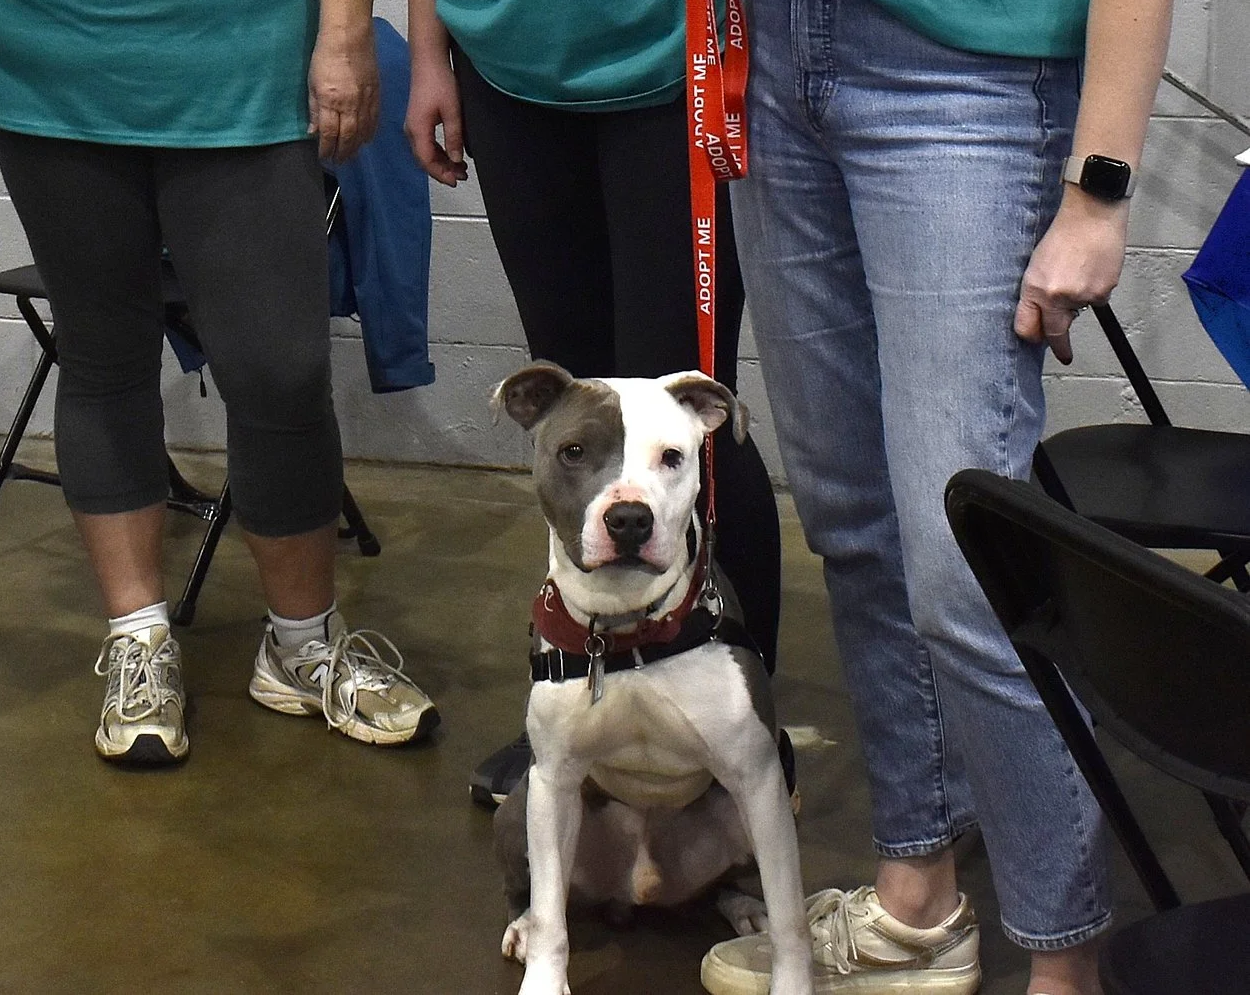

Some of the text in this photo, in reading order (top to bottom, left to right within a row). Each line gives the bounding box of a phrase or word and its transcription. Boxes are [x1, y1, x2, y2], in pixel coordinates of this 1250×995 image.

[693, 53, 707, 80] ME
[725, 112, 741, 138] ME
[705, 132, 734, 179] ADOPT
[697, 216, 712, 316] ADOPT ME
